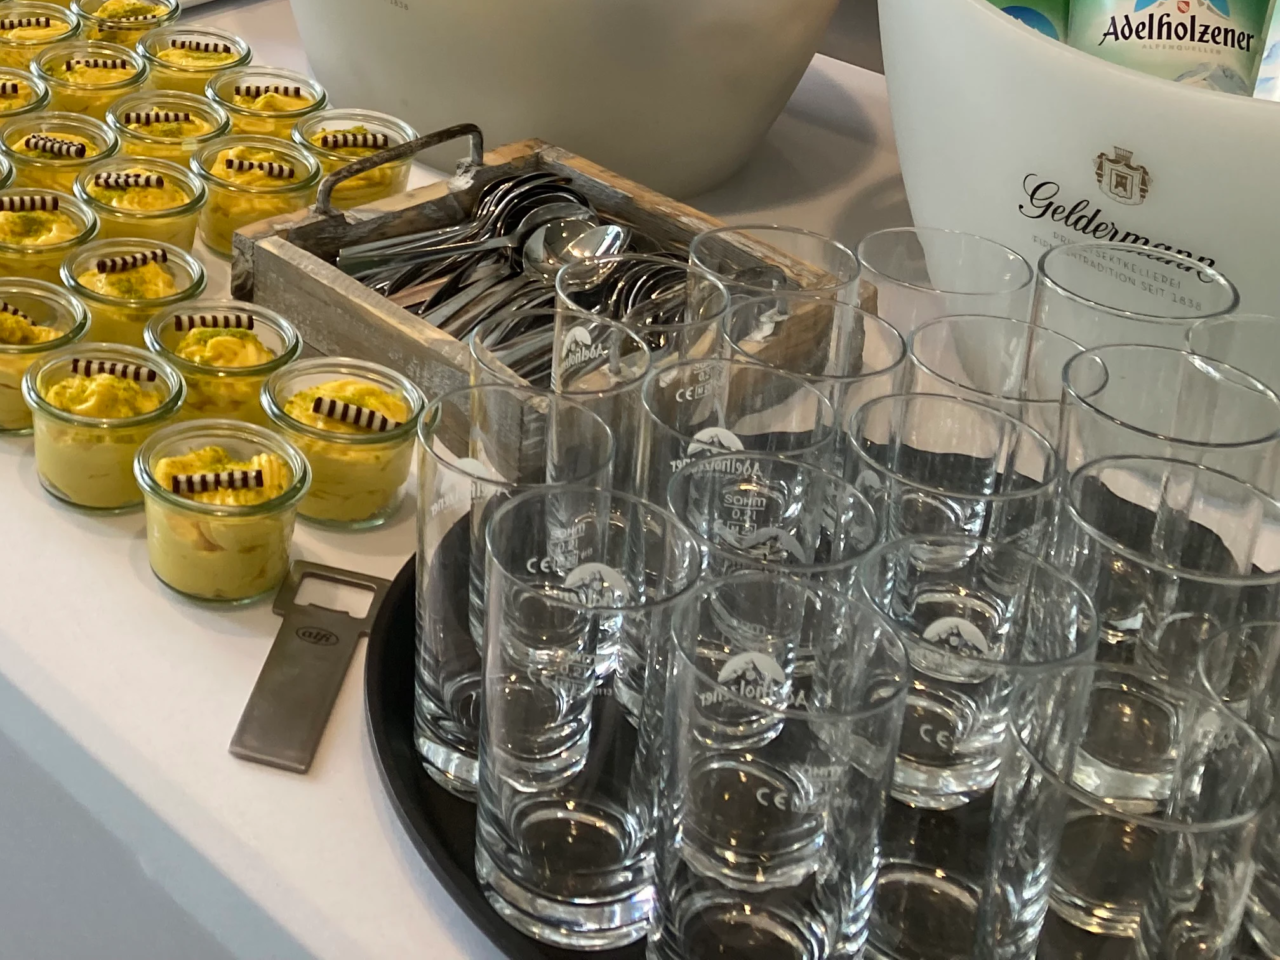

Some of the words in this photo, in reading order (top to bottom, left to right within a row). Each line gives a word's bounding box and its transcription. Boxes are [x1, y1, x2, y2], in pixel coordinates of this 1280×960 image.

[1097, 12, 1255, 52] Adelholzener
[1018, 173, 1217, 284] Geldermann
[1140, 280, 1166, 299] SEIT
[1171, 292, 1202, 312] 1838
